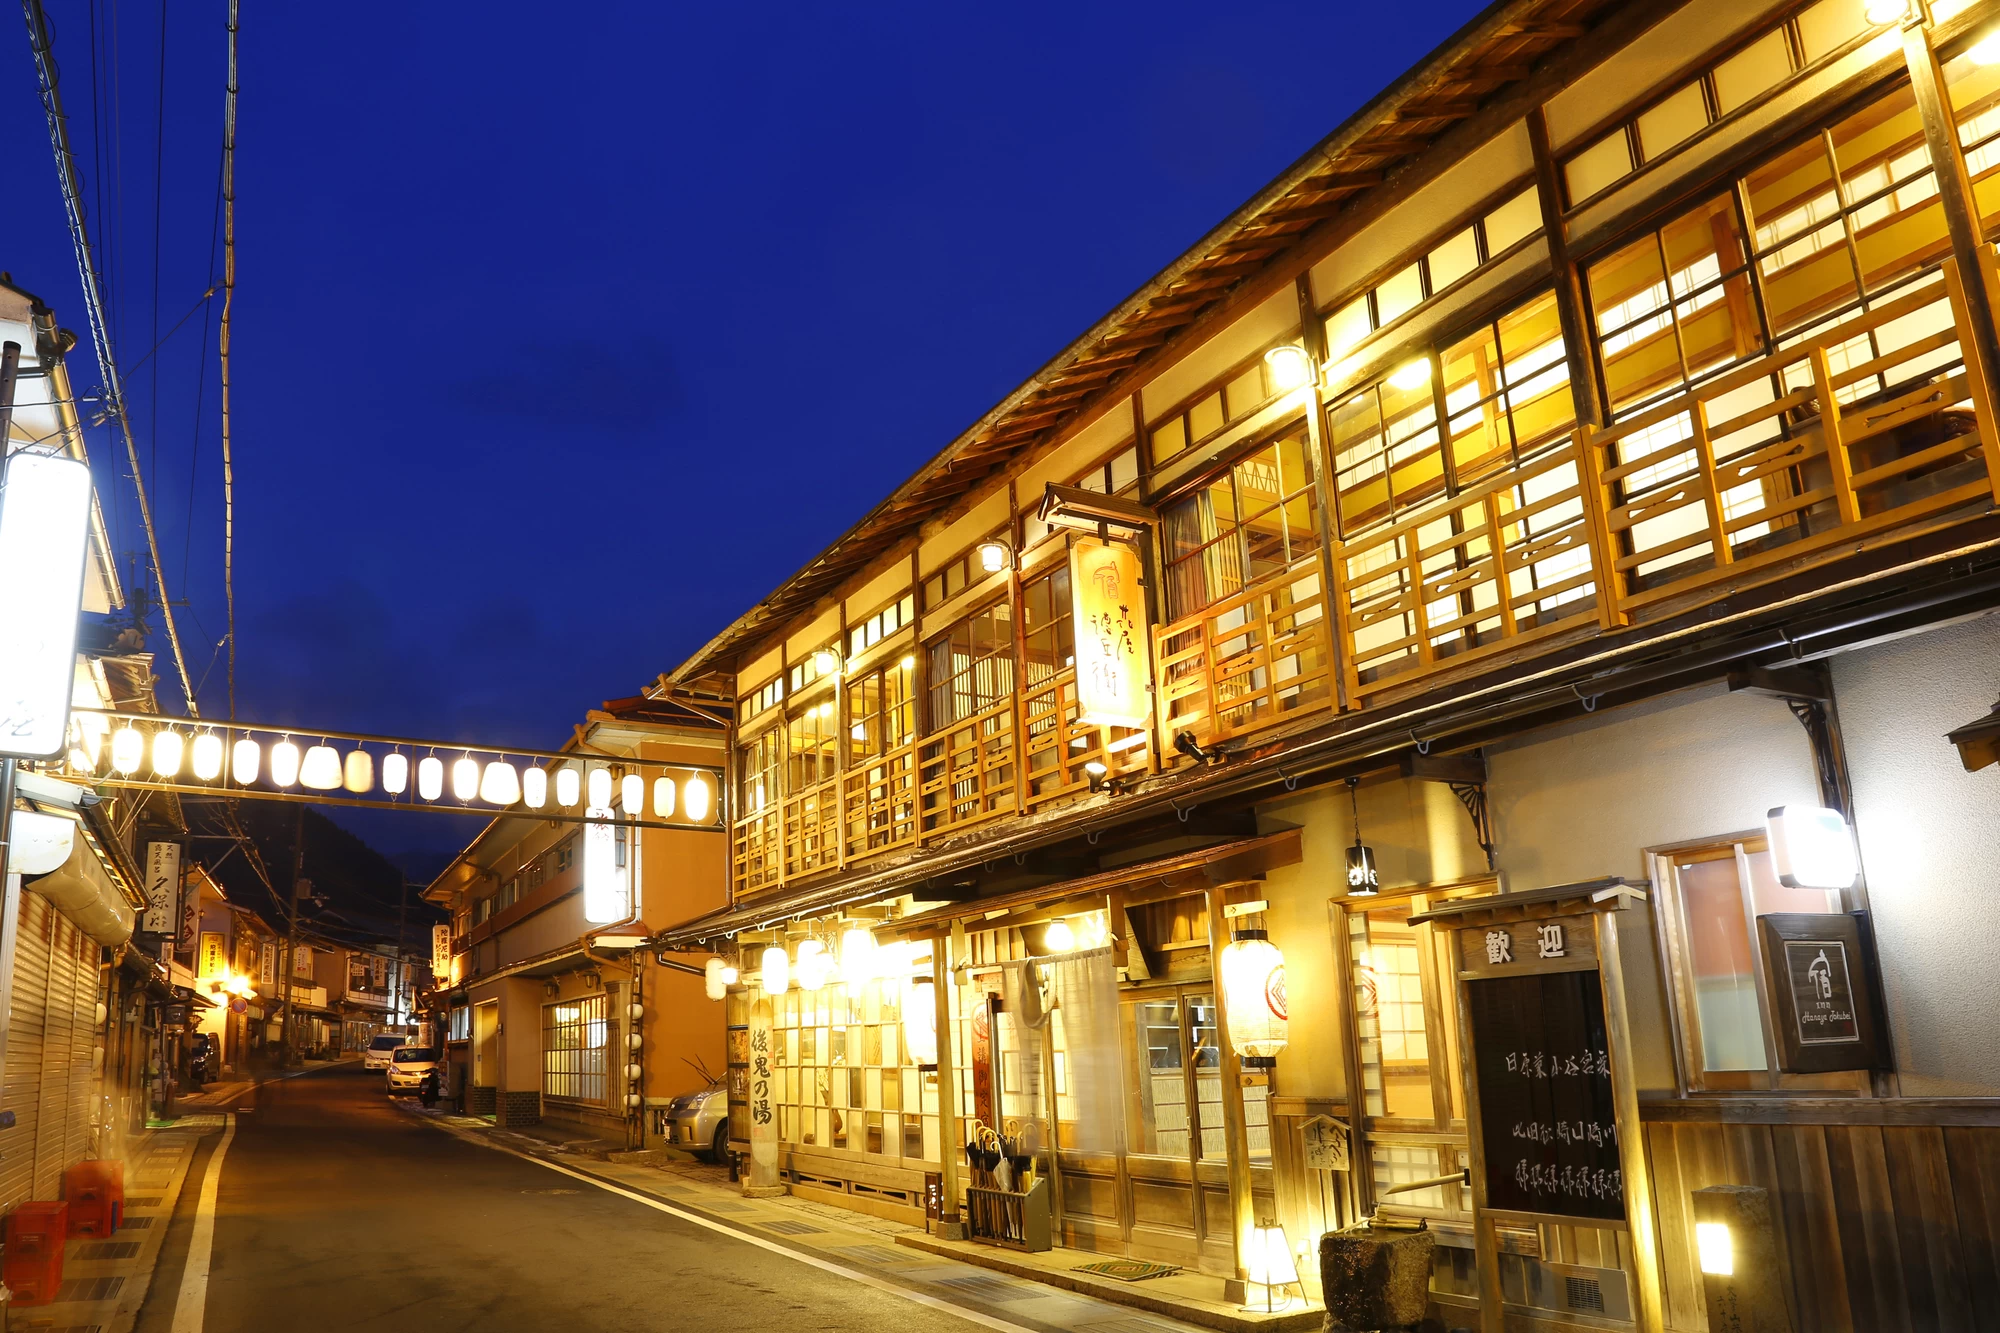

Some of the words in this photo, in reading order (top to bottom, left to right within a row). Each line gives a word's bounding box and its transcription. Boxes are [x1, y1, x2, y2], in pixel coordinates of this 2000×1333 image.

[1485, 924, 1565, 965] 歓迎
[1808, 949, 1832, 1000] 宿
[1802, 1010, 1828, 1026] Hanaya
[1829, 1009, 1852, 1023] Tokubei
